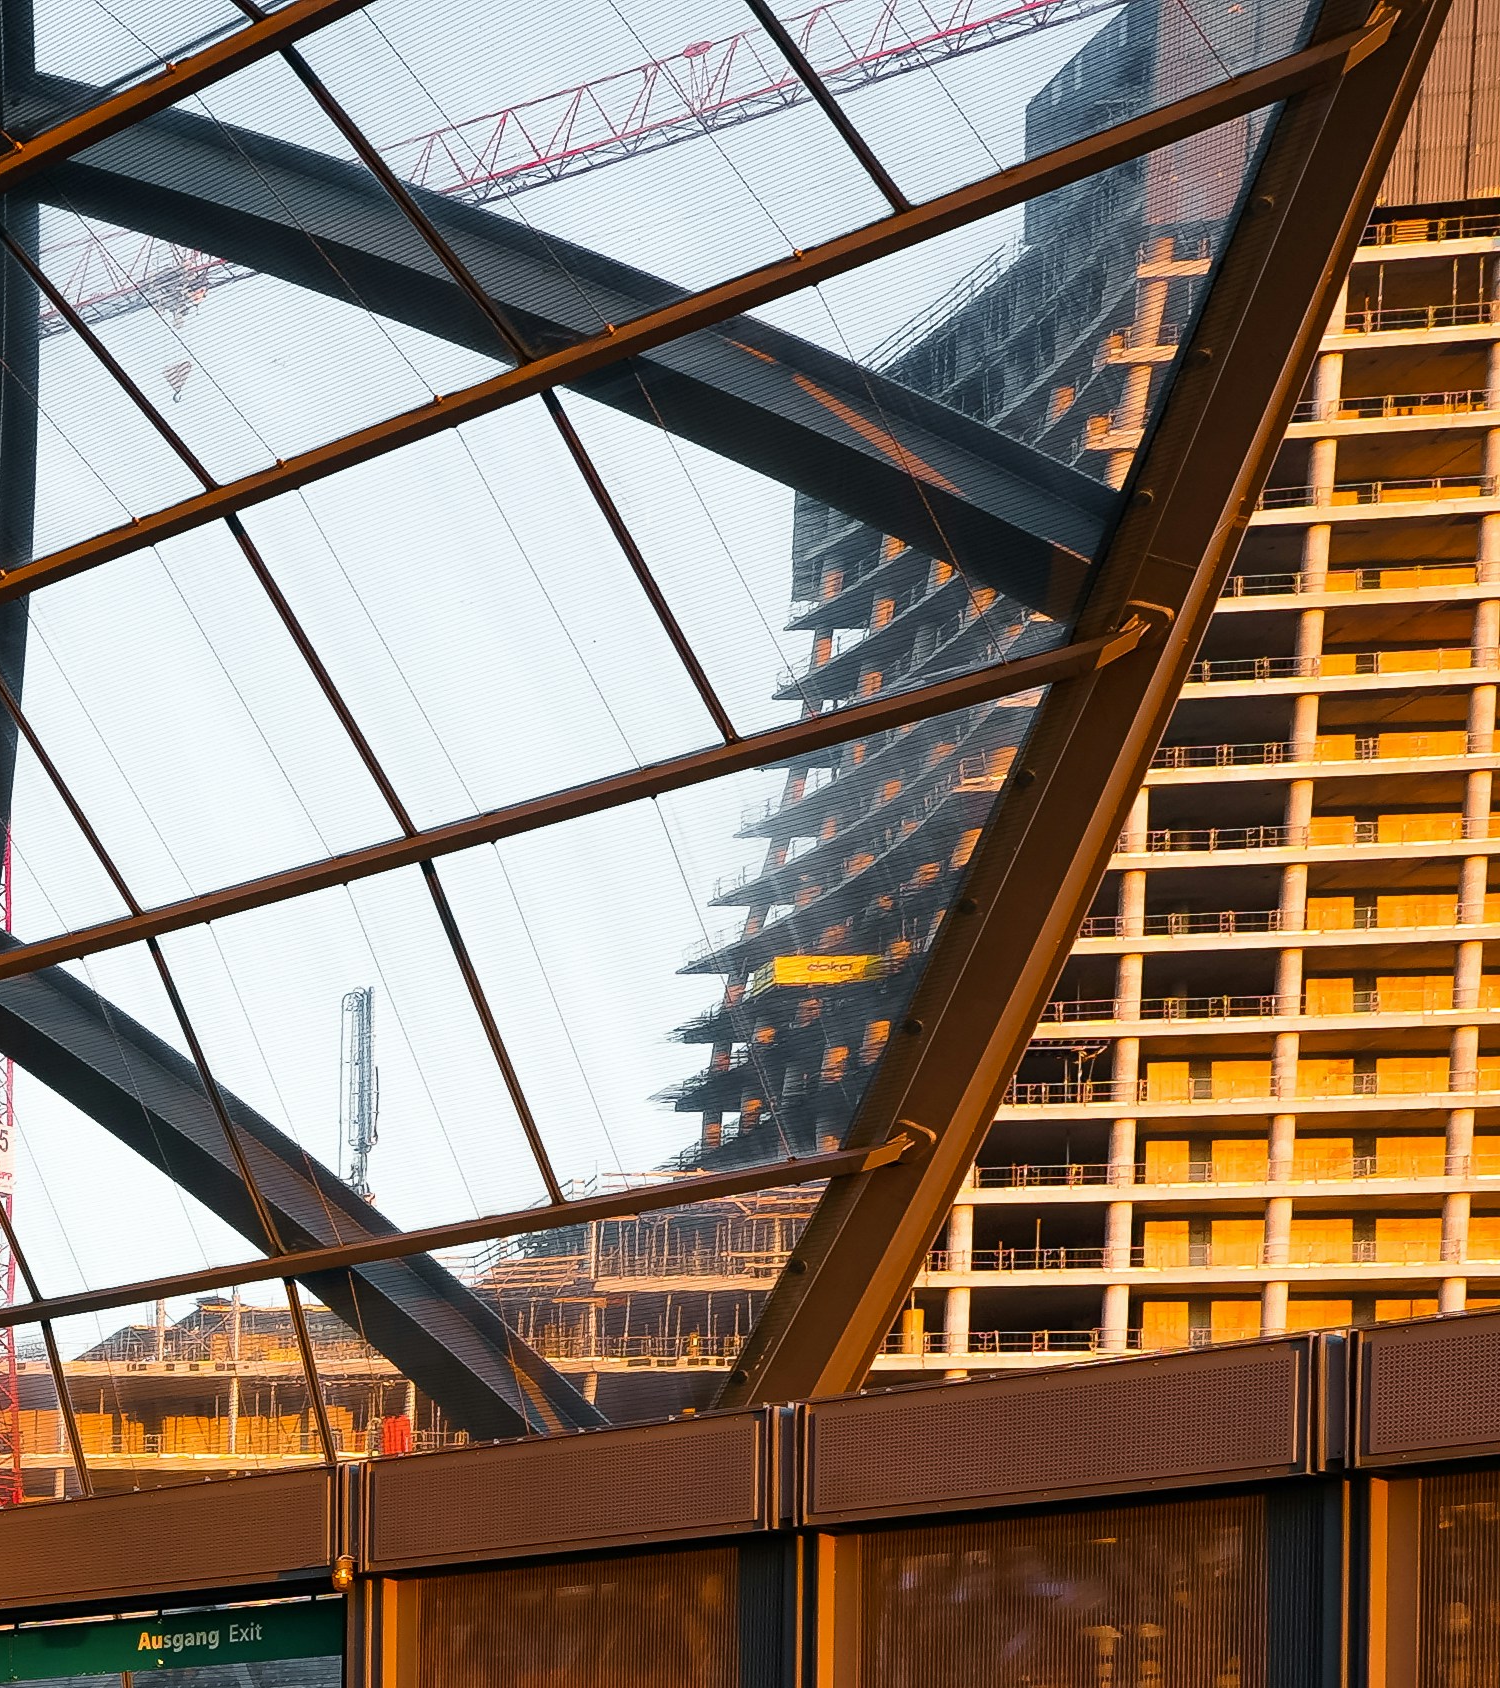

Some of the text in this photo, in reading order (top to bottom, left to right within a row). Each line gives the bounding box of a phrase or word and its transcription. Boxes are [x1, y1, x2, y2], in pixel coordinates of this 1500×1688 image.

[0, 1129, 9, 1152] 5
[137, 1621, 263, 1653] Ausgang Exit
